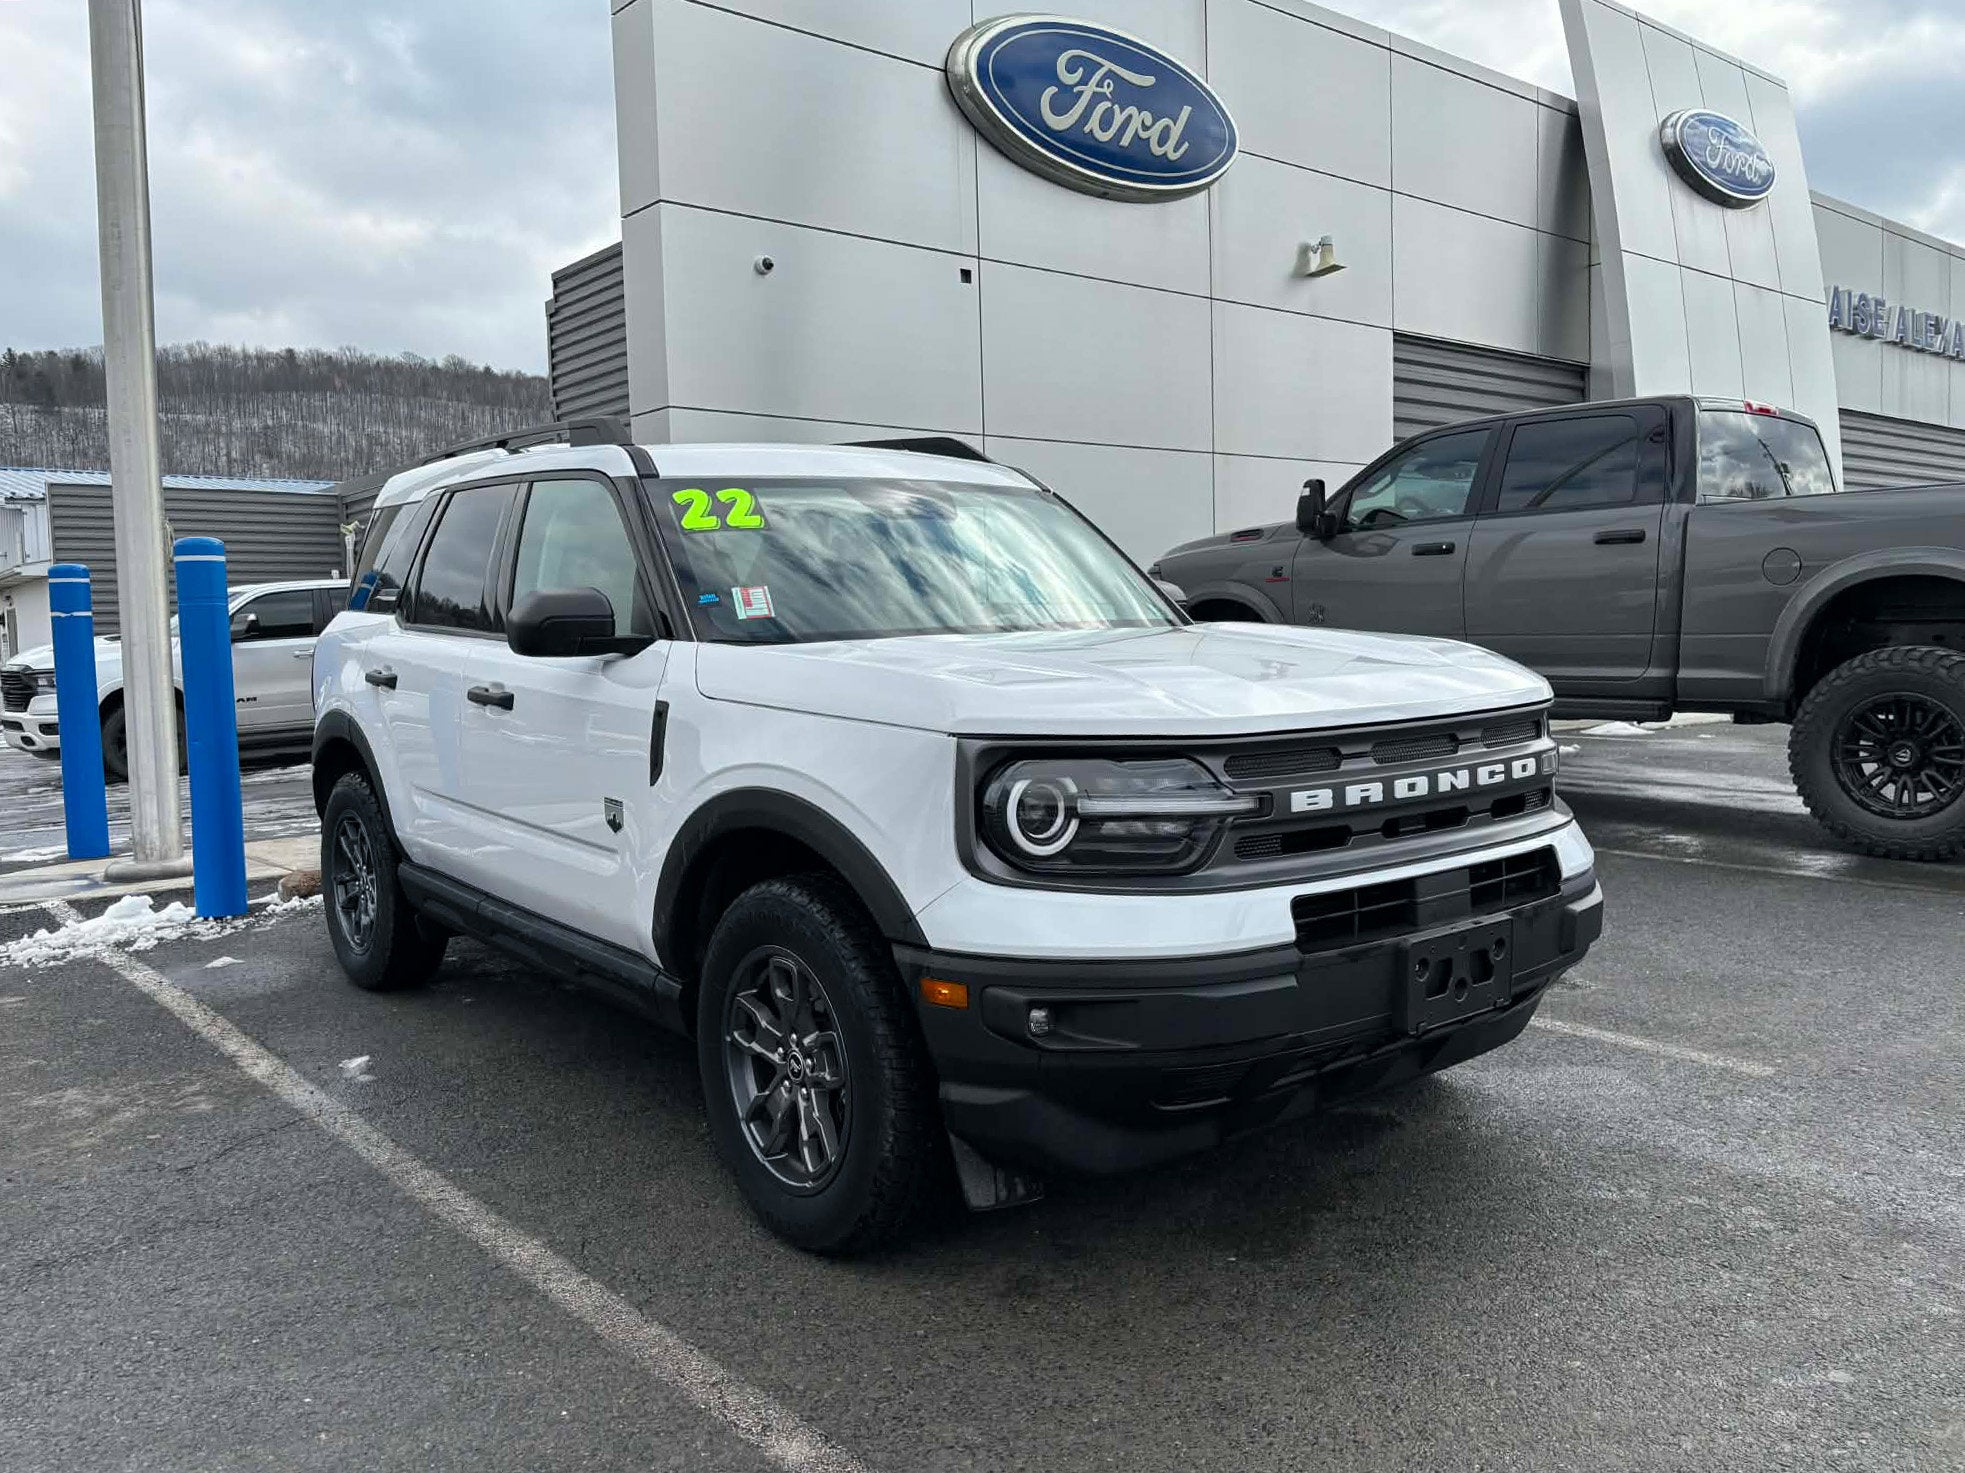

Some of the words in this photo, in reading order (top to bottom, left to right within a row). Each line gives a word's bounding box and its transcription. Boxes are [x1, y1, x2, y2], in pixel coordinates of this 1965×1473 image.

[1040, 49, 1193, 161] Ford
[1705, 126, 1760, 182] Ford
[1826, 284, 1886, 338] AISE
[1891, 304, 1965, 359] ALEXA
[672, 488, 765, 531] 22
[1290, 757, 1536, 813] BRONCO
